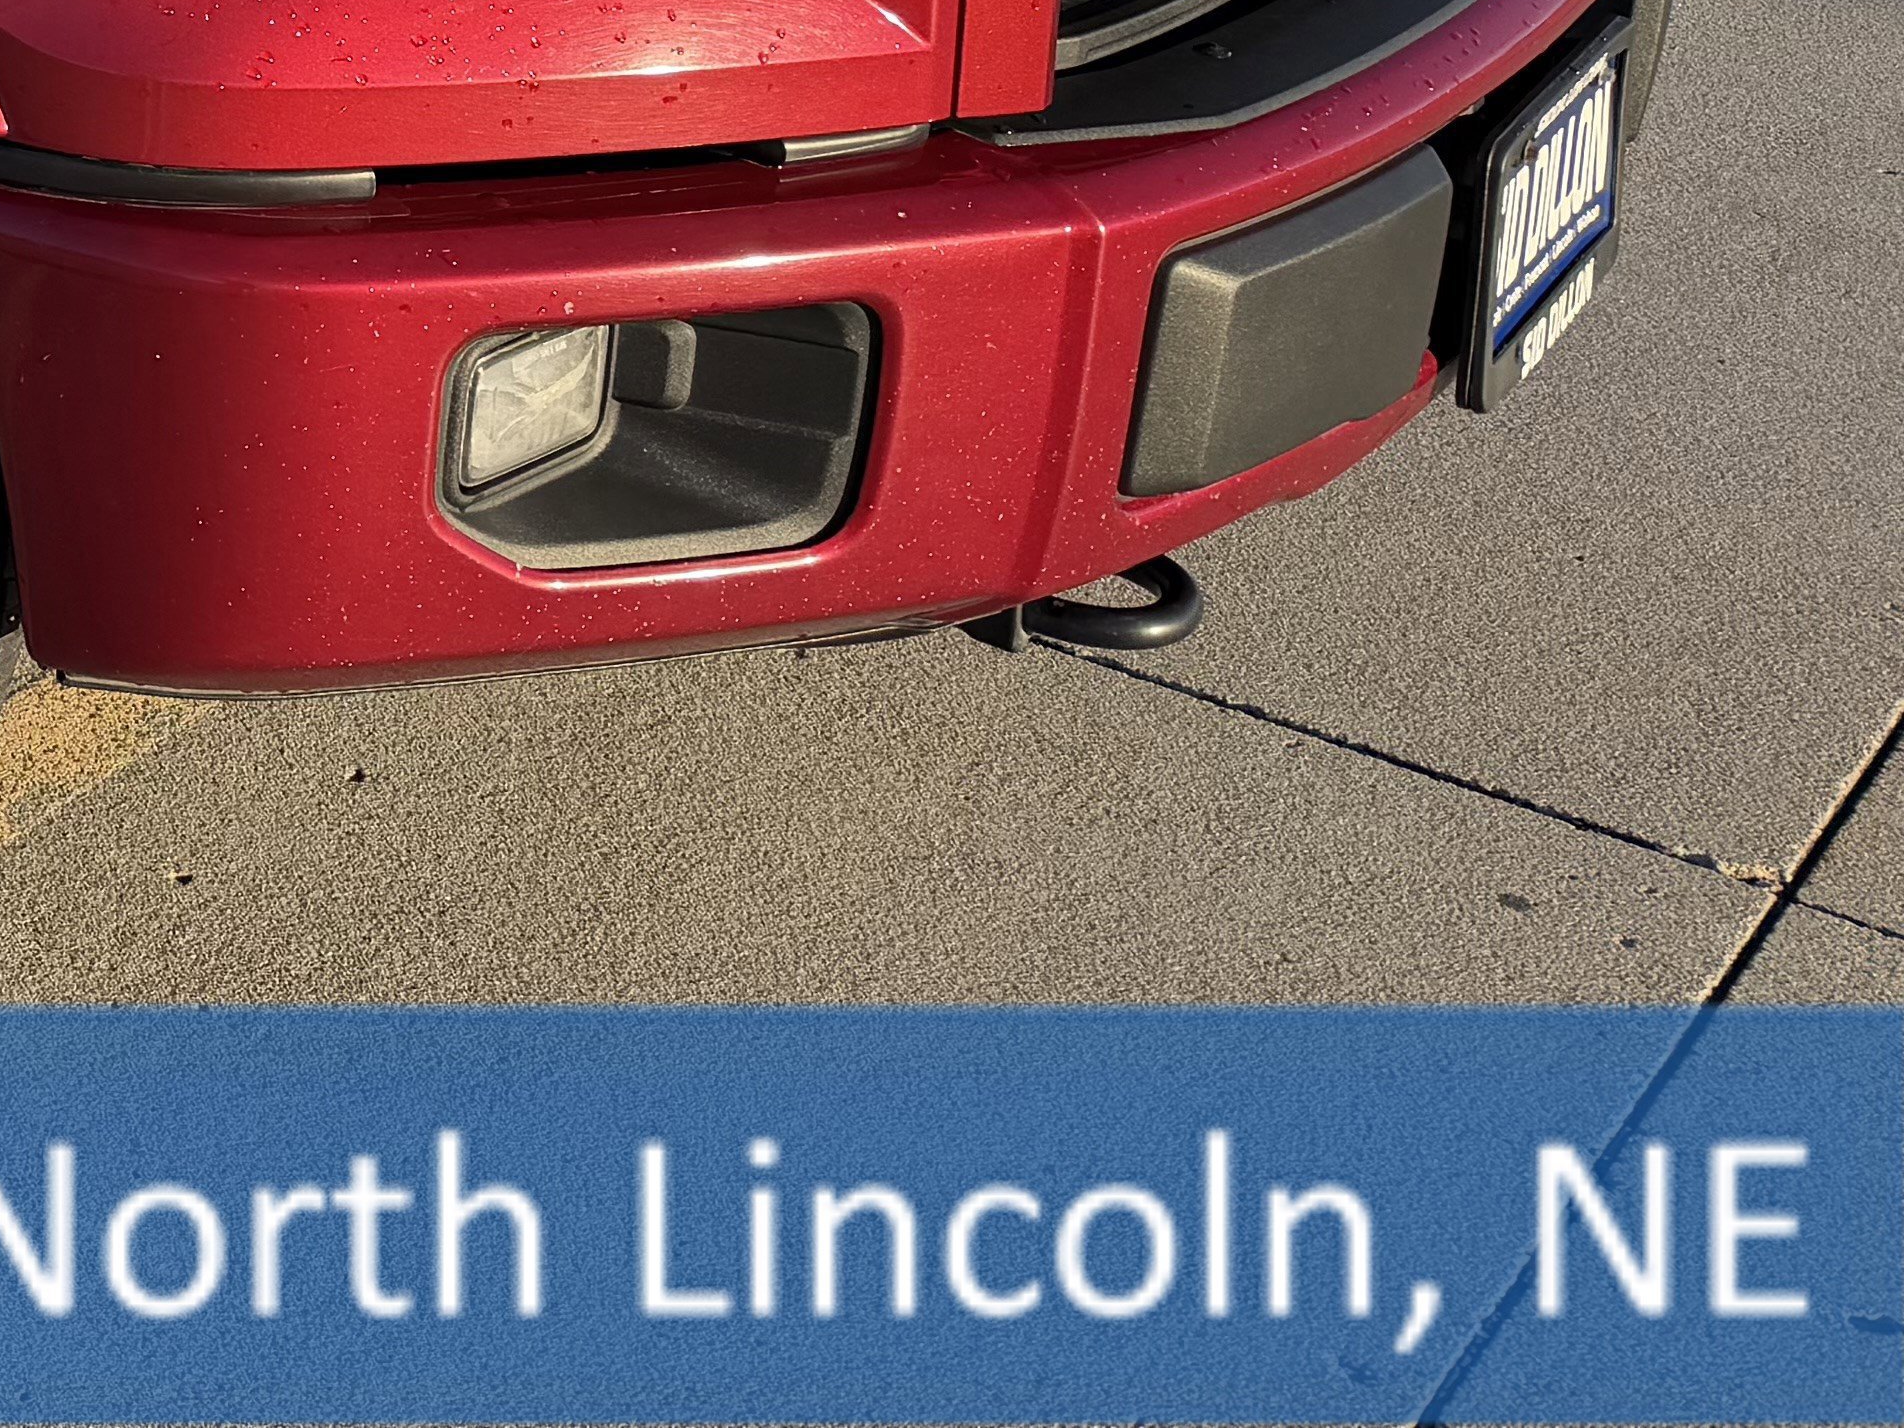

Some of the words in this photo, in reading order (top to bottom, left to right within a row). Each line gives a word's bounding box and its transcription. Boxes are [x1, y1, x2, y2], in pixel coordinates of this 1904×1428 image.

[1523, 80, 1612, 268] DILLON
[1520, 316, 1547, 380] SID
[1546, 256, 1595, 352] DILLON
